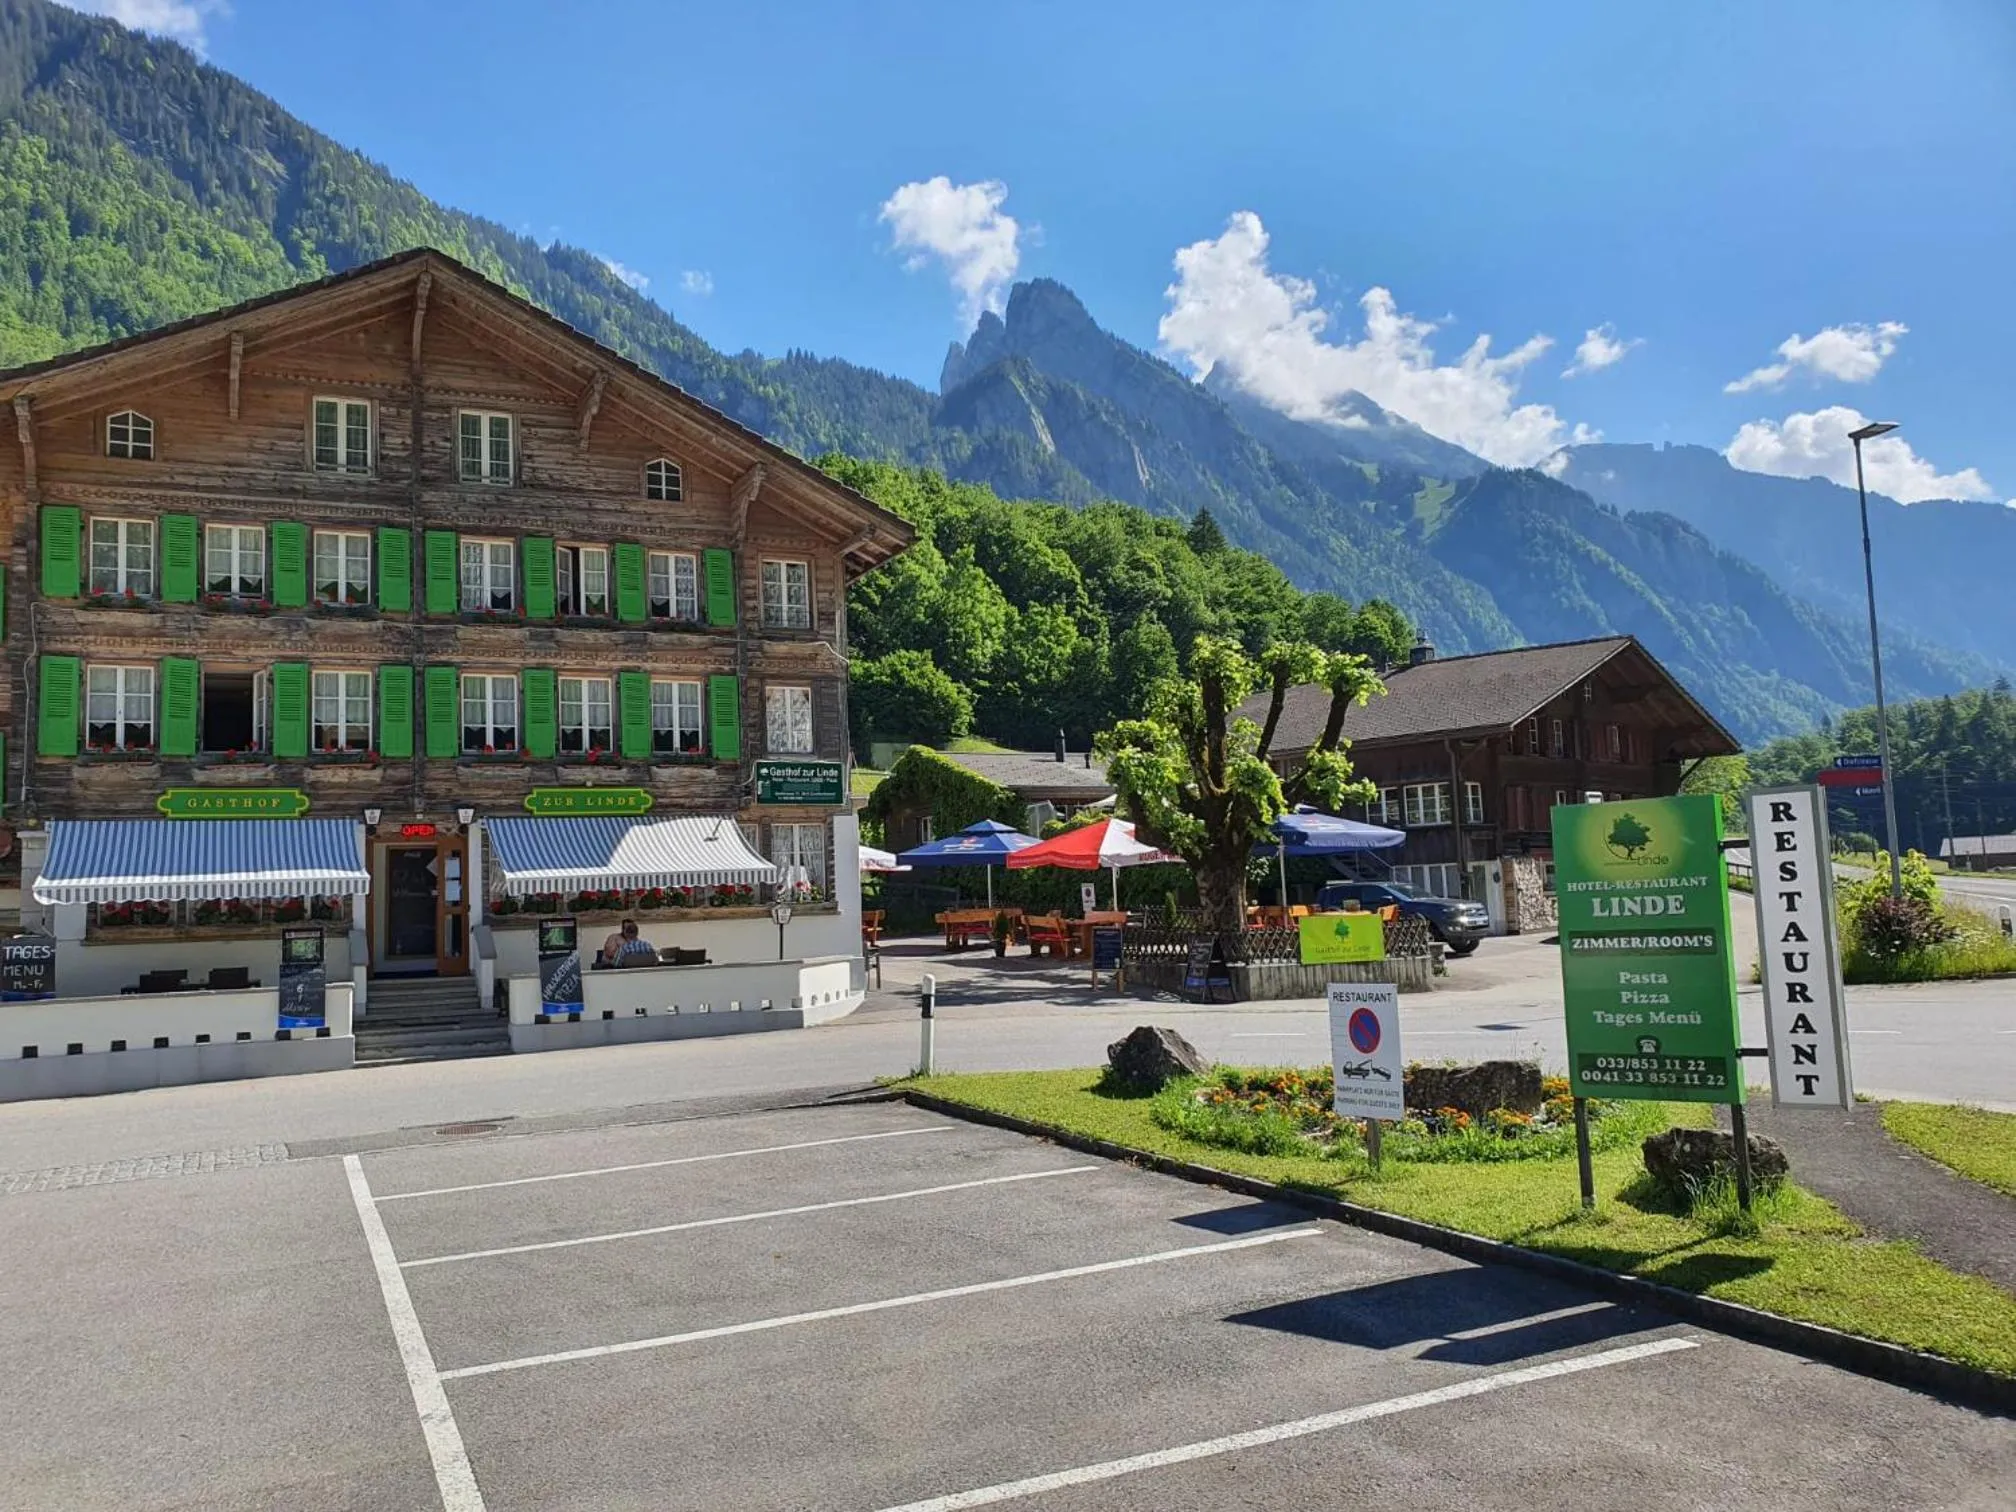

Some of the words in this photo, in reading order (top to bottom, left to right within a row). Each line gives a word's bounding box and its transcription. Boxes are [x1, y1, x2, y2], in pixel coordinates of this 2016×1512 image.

[769, 766, 800, 776] Gasthof
[816, 767, 839, 777] Linde
[187, 798, 281, 809] GASTHOF
[543, 797, 574, 806] ZUR
[585, 796, 636, 806] LINDE
[402, 824, 435, 836] OPEN
[1637, 854, 1670, 866] Linde
[1567, 876, 1708, 892] HOTEL-RESTAURANT
[1592, 895, 1686, 917] LINDE
[1572, 935, 1714, 949] ZIMMER/ROOM'S
[1769, 801, 1820, 1096] RESTAURANT
[2, 945, 57, 960] TAGES-
[3, 964, 45, 977] MENU
[1619, 971, 1669, 984] Pasta
[1333, 992, 1392, 1002] RESTAURANT
[1620, 991, 1670, 1004] Pizza
[1593, 1011, 1643, 1026] Tages
[1649, 1011, 1702, 1025] Menü
[1596, 1057, 1659, 1070] 033/853
[1665, 1060, 1682, 1070] 11
[1687, 1060, 1706, 1071] 22
[1581, 1070, 1619, 1082] 0041
[1624, 1071, 1644, 1083] 33
[1649, 1072, 1677, 1084] 853
[1683, 1073, 1701, 1085] 11
[1706, 1074, 1726, 1086] 22
